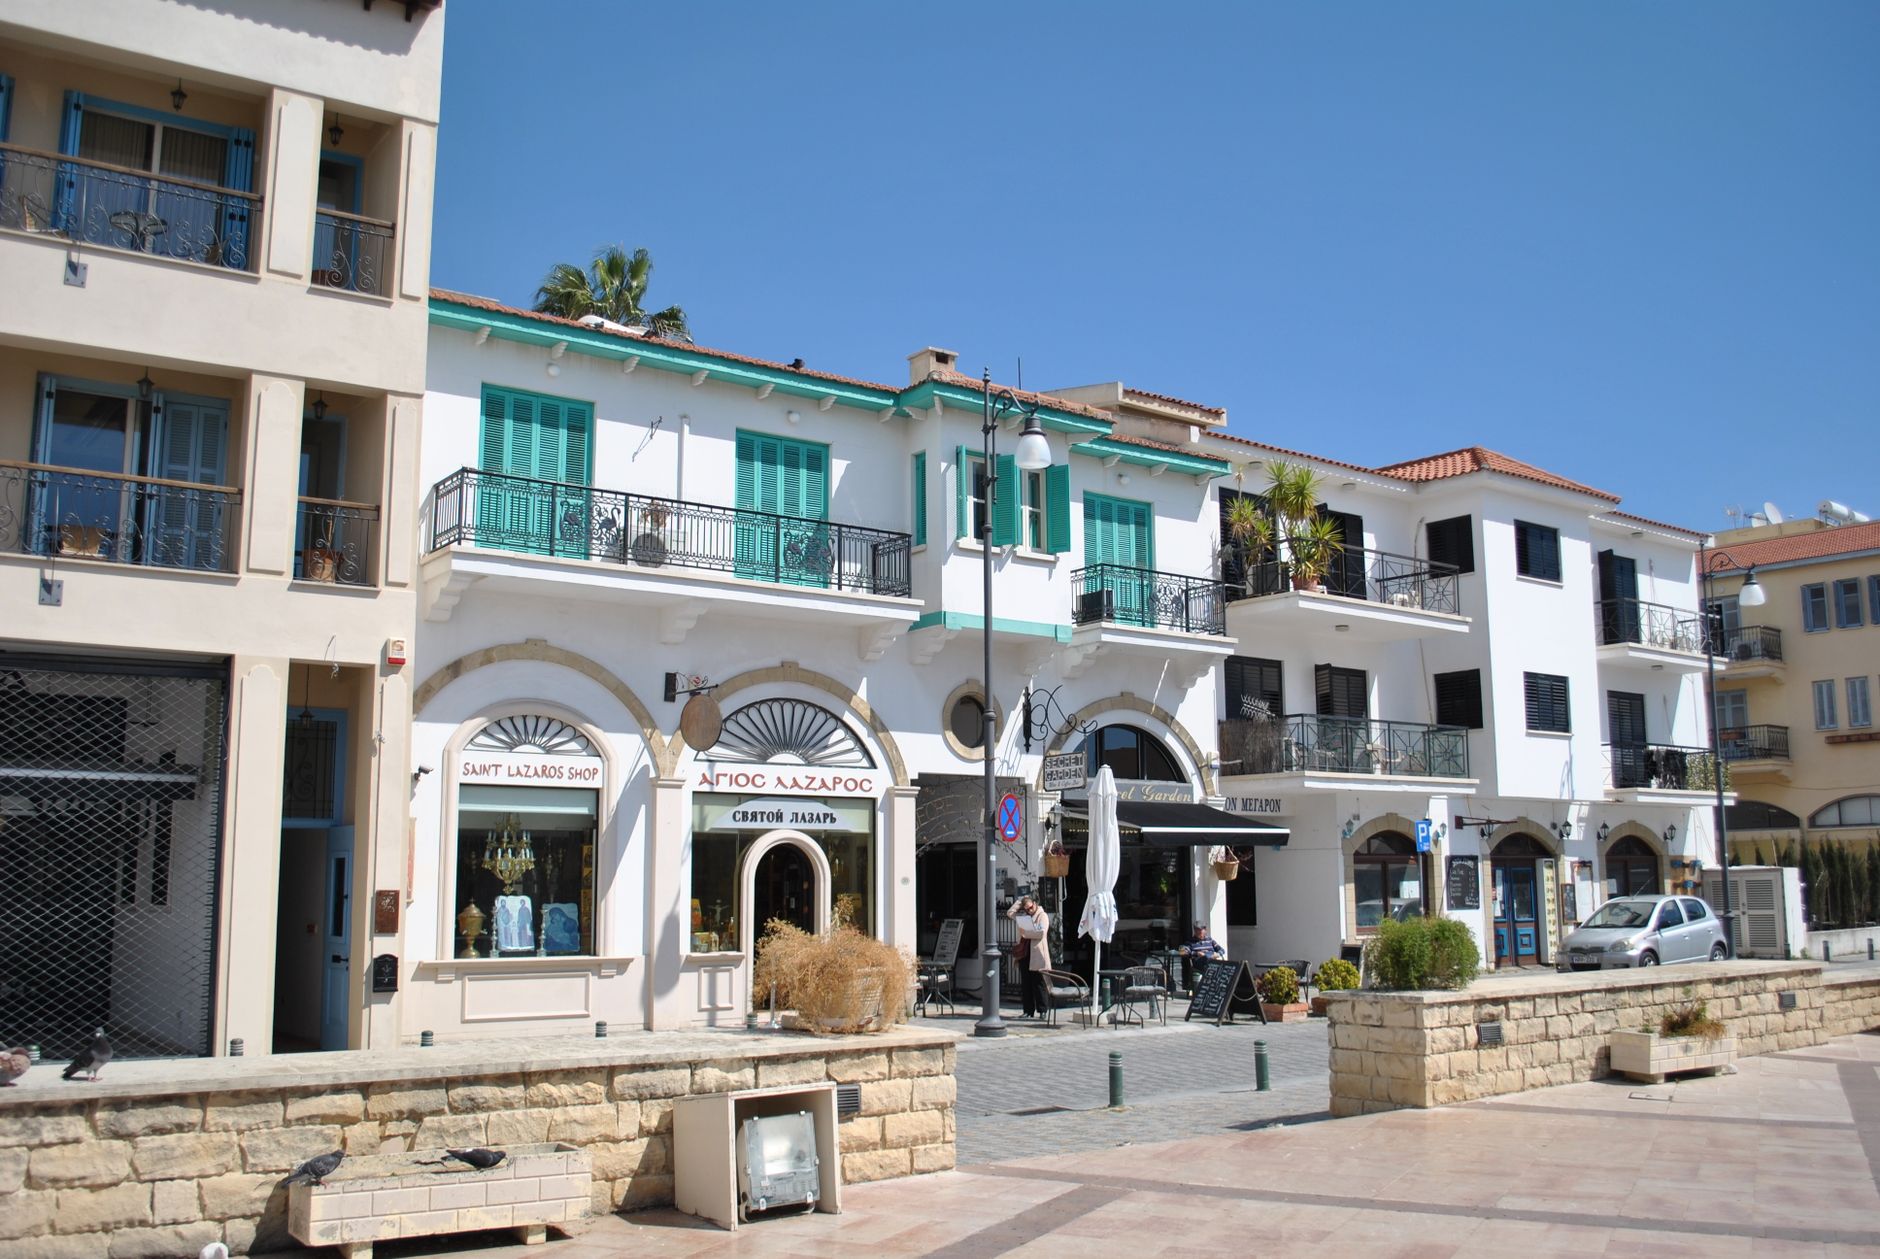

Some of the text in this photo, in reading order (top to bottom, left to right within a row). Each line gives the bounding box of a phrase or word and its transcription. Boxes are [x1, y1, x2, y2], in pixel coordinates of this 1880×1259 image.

[462, 762, 599, 781] SAINT LAZAROS SHOP
[1046, 767, 1083, 781] GARDEN
[1141, 783, 1192, 802] Garden
[732, 809, 837, 824] СВЯТОЙ ЛАЗАРЬ
[1418, 823, 1427, 842] P
